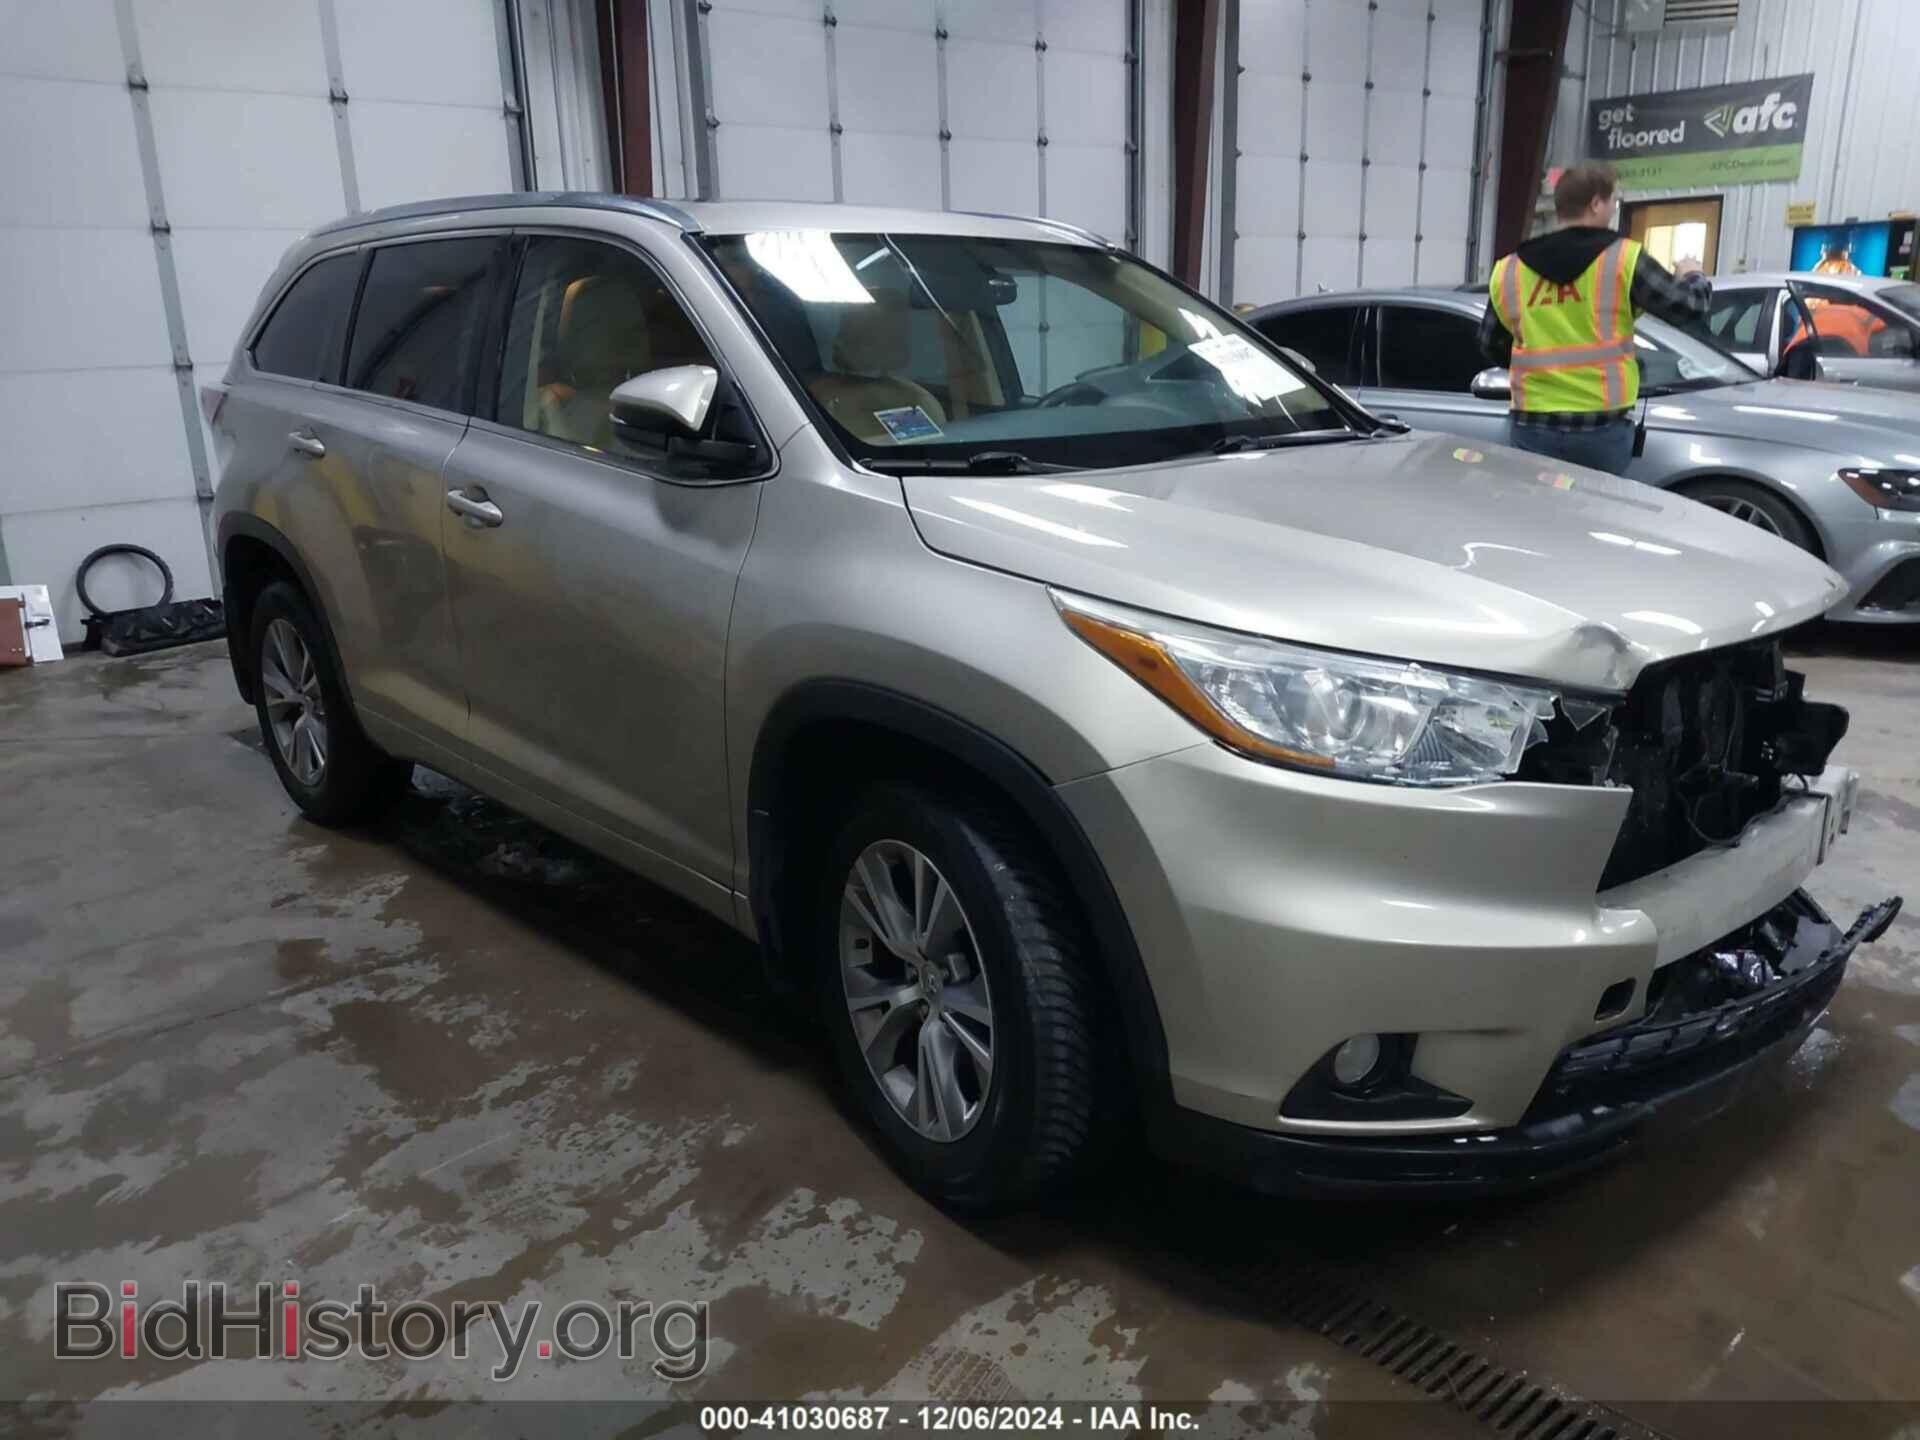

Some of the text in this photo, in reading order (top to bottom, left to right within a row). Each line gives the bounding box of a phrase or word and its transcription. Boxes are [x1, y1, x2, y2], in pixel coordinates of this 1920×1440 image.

[1599, 103, 1635, 130] get
[1732, 91, 1797, 134] afc
[1608, 120, 1685, 149] floored
